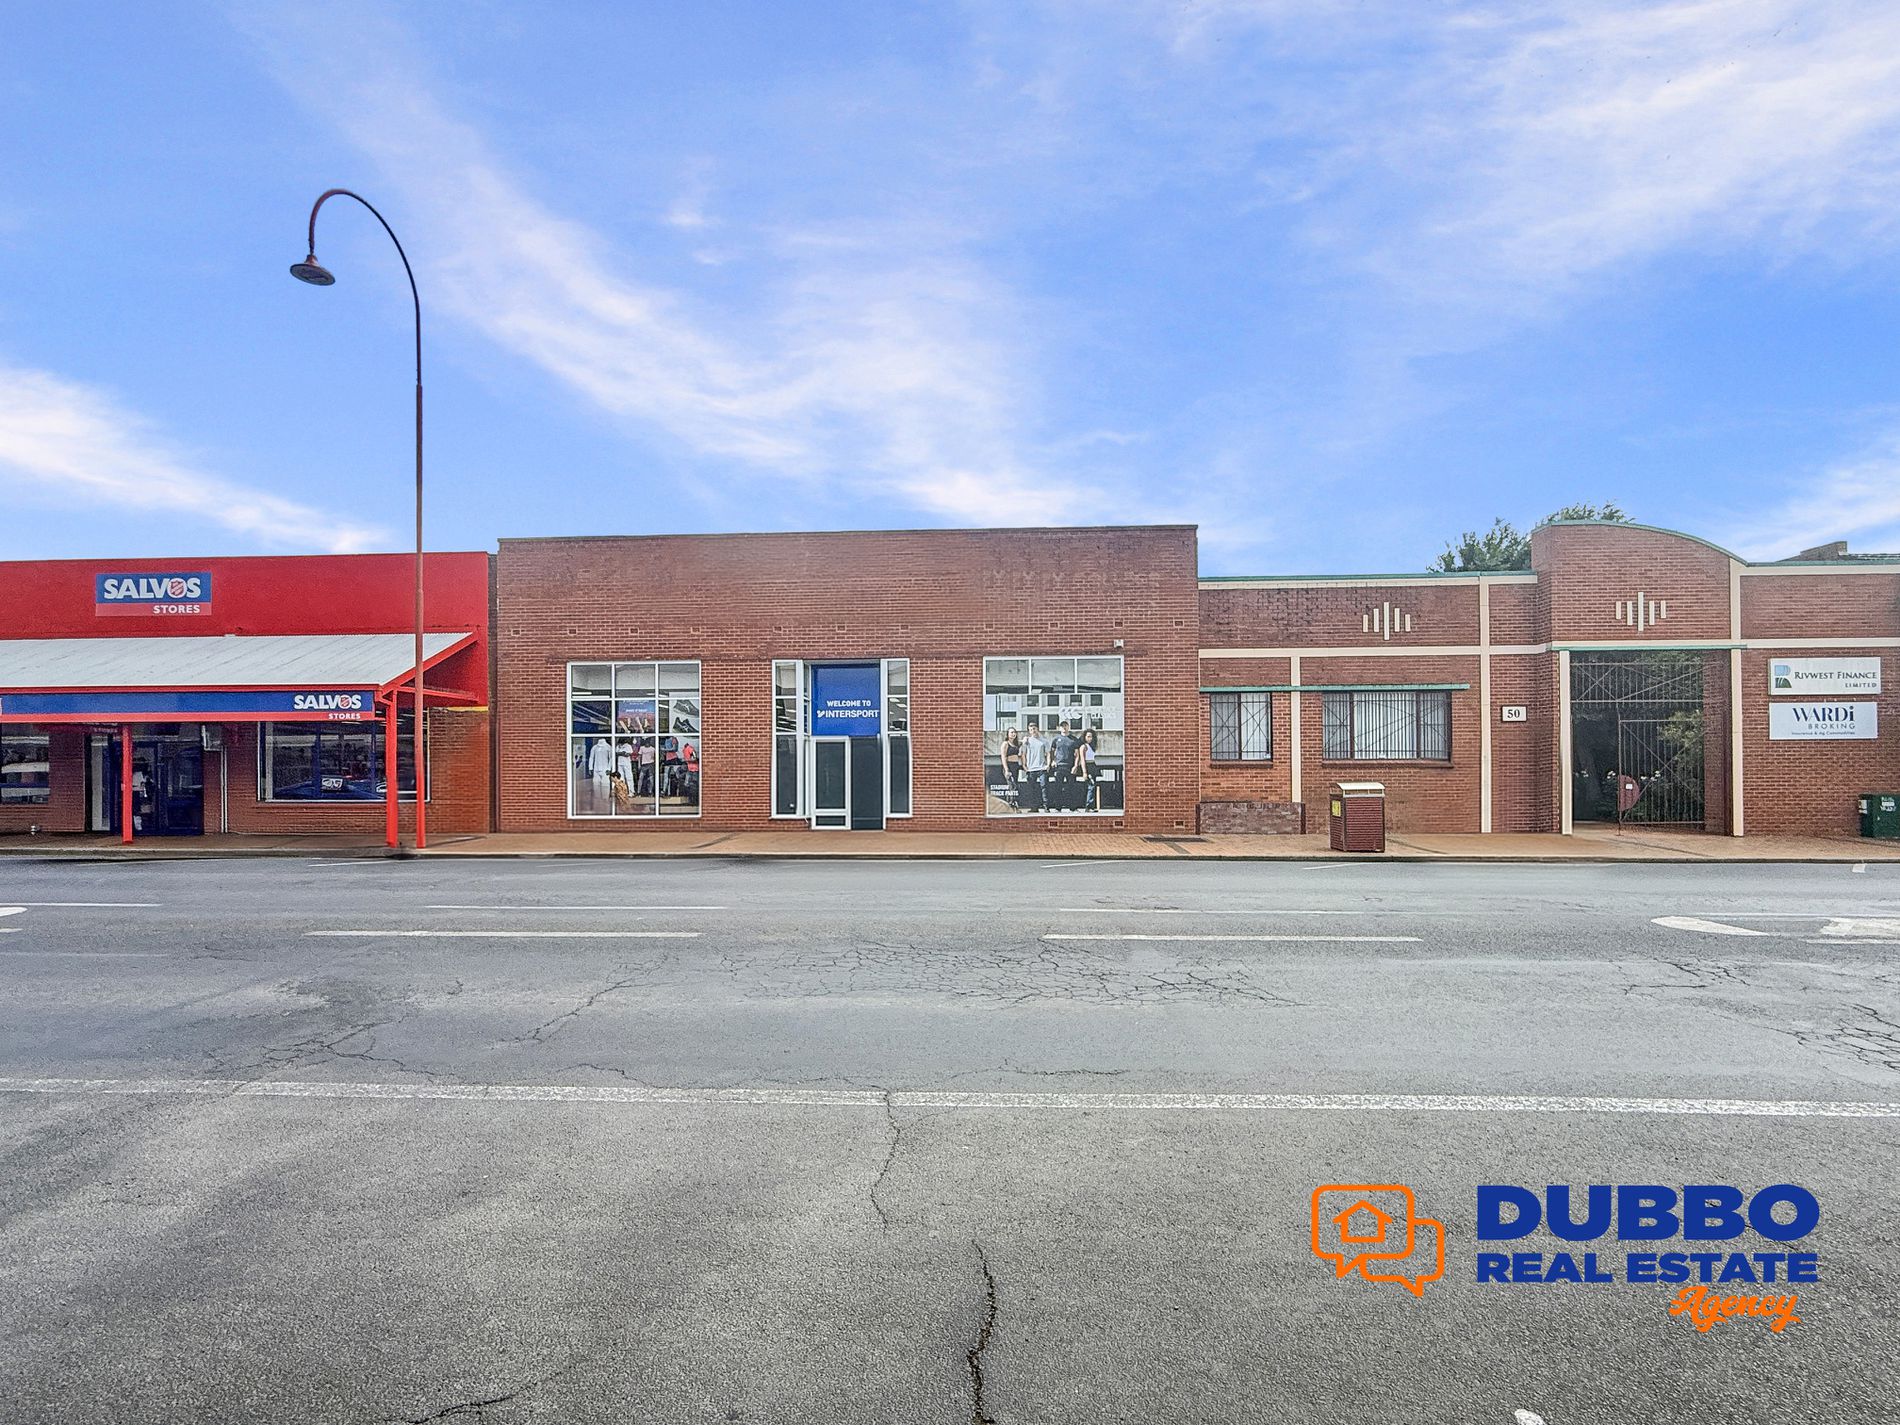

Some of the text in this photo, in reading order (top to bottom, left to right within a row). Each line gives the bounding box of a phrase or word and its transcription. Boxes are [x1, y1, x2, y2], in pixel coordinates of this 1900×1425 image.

[104, 577, 201, 599] SALVOS
[153, 604, 201, 614] STORES
[1837, 671, 1878, 680] FINANCE
[294, 694, 362, 710] SALVOS
[328, 712, 361, 720] STORES
[825, 710, 880, 718] INTERSPORT
[1507, 709, 1521, 719] 50
